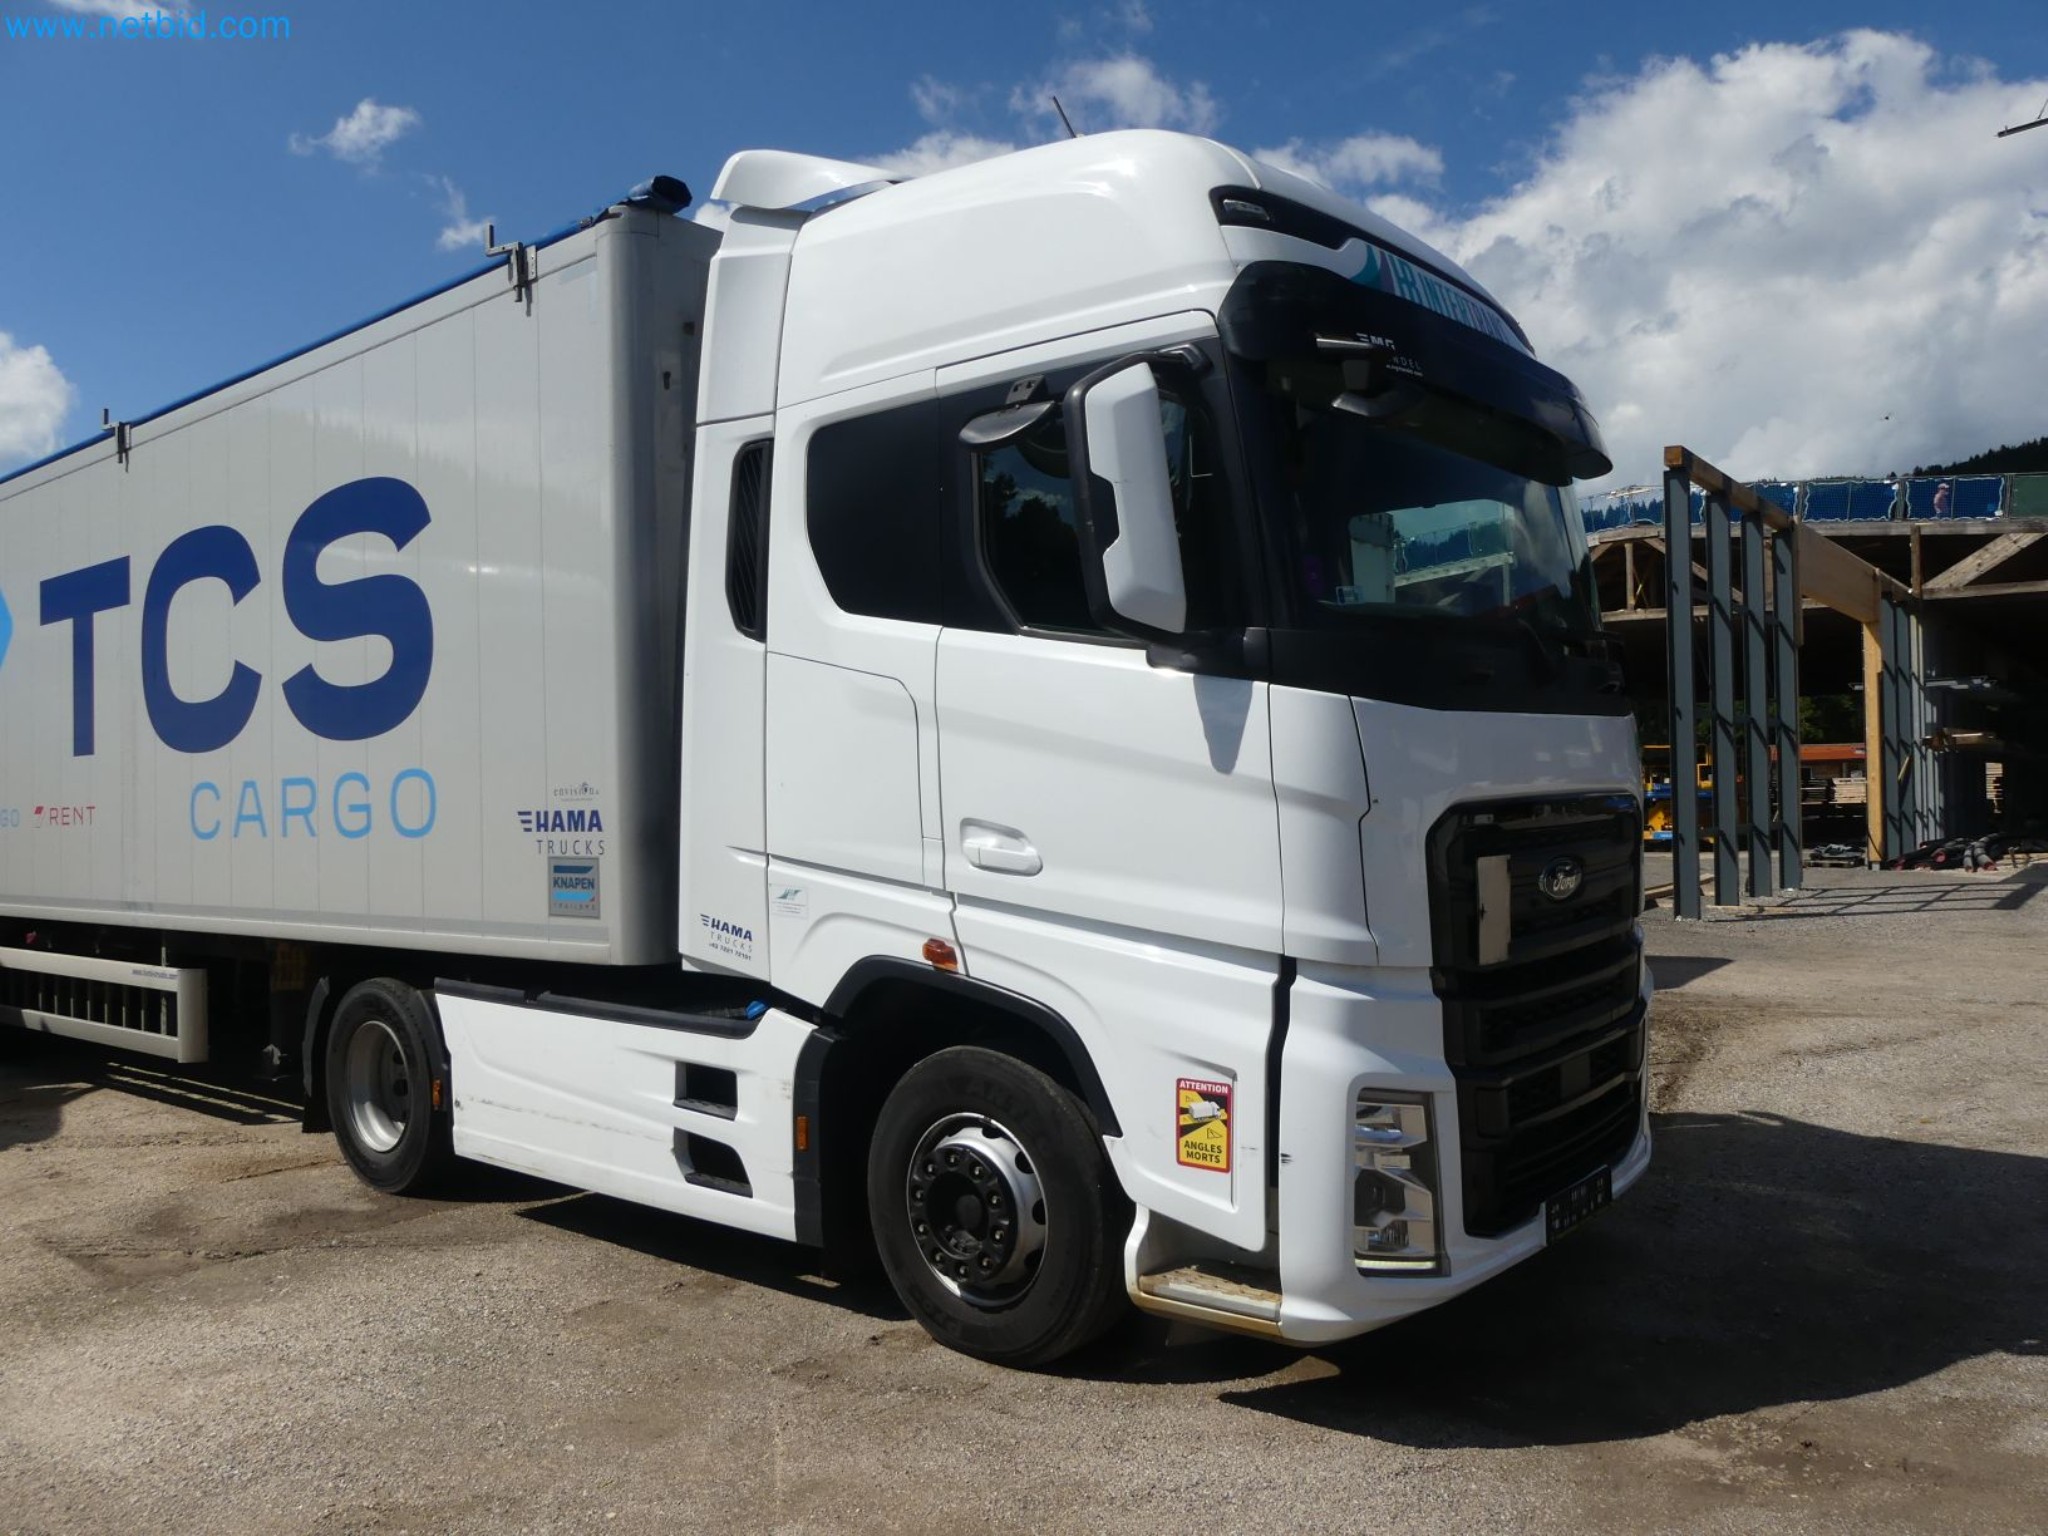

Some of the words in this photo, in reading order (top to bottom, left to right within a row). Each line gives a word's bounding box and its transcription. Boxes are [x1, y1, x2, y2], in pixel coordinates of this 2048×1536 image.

[40, 476, 433, 757] TCS
[190, 768, 437, 840] CARGO
[49, 805, 96, 826] RENT
[536, 839, 606, 855] TRUCKS
[552, 876, 595, 890] KNAPEN
[1180, 1080, 1229, 1094] ATTENTION
[1184, 1140, 1223, 1154] ANGLES
[1186, 1150, 1221, 1164] MORTS
